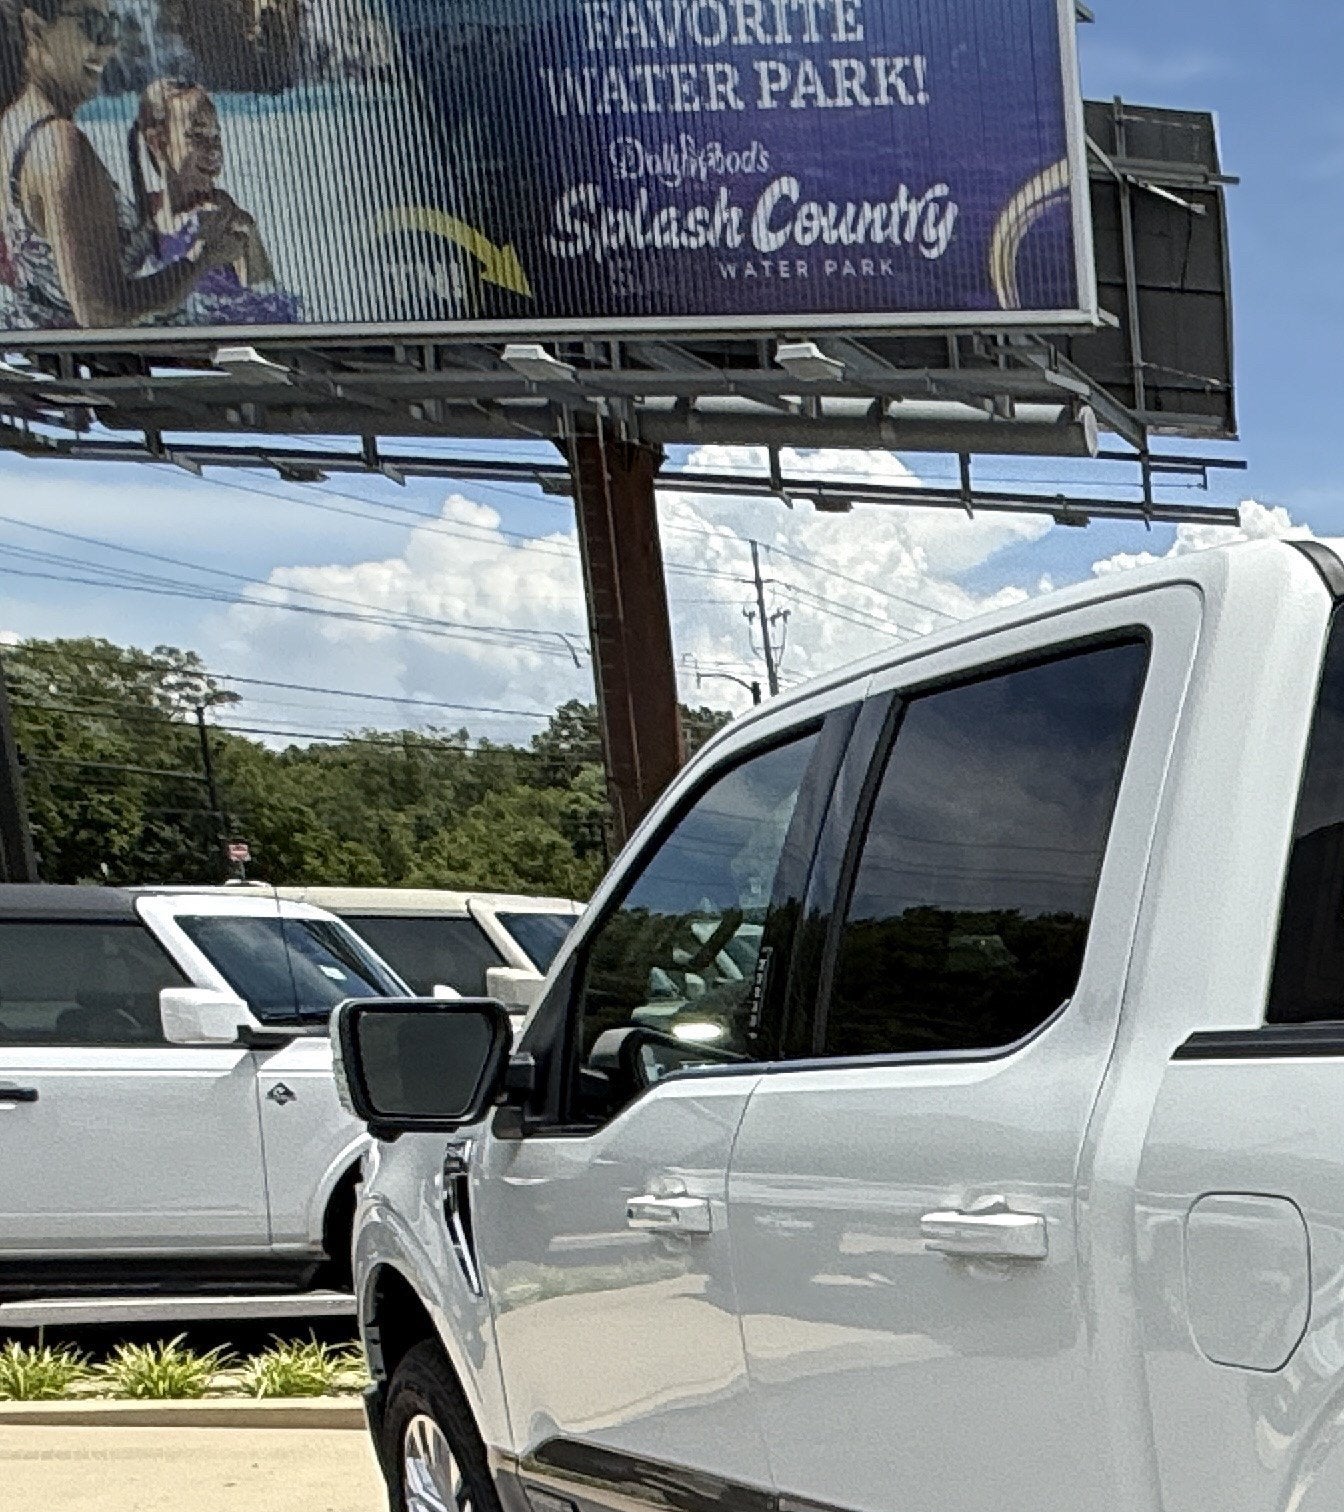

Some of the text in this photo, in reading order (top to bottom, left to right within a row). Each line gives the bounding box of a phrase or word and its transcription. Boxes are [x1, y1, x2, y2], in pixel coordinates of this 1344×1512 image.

[583, 0, 865, 50] FAVORITE
[540, 55, 931, 116] WATER PARK!
[543, 176, 959, 261] Splash Country
[717, 258, 894, 279] WATER PARK
